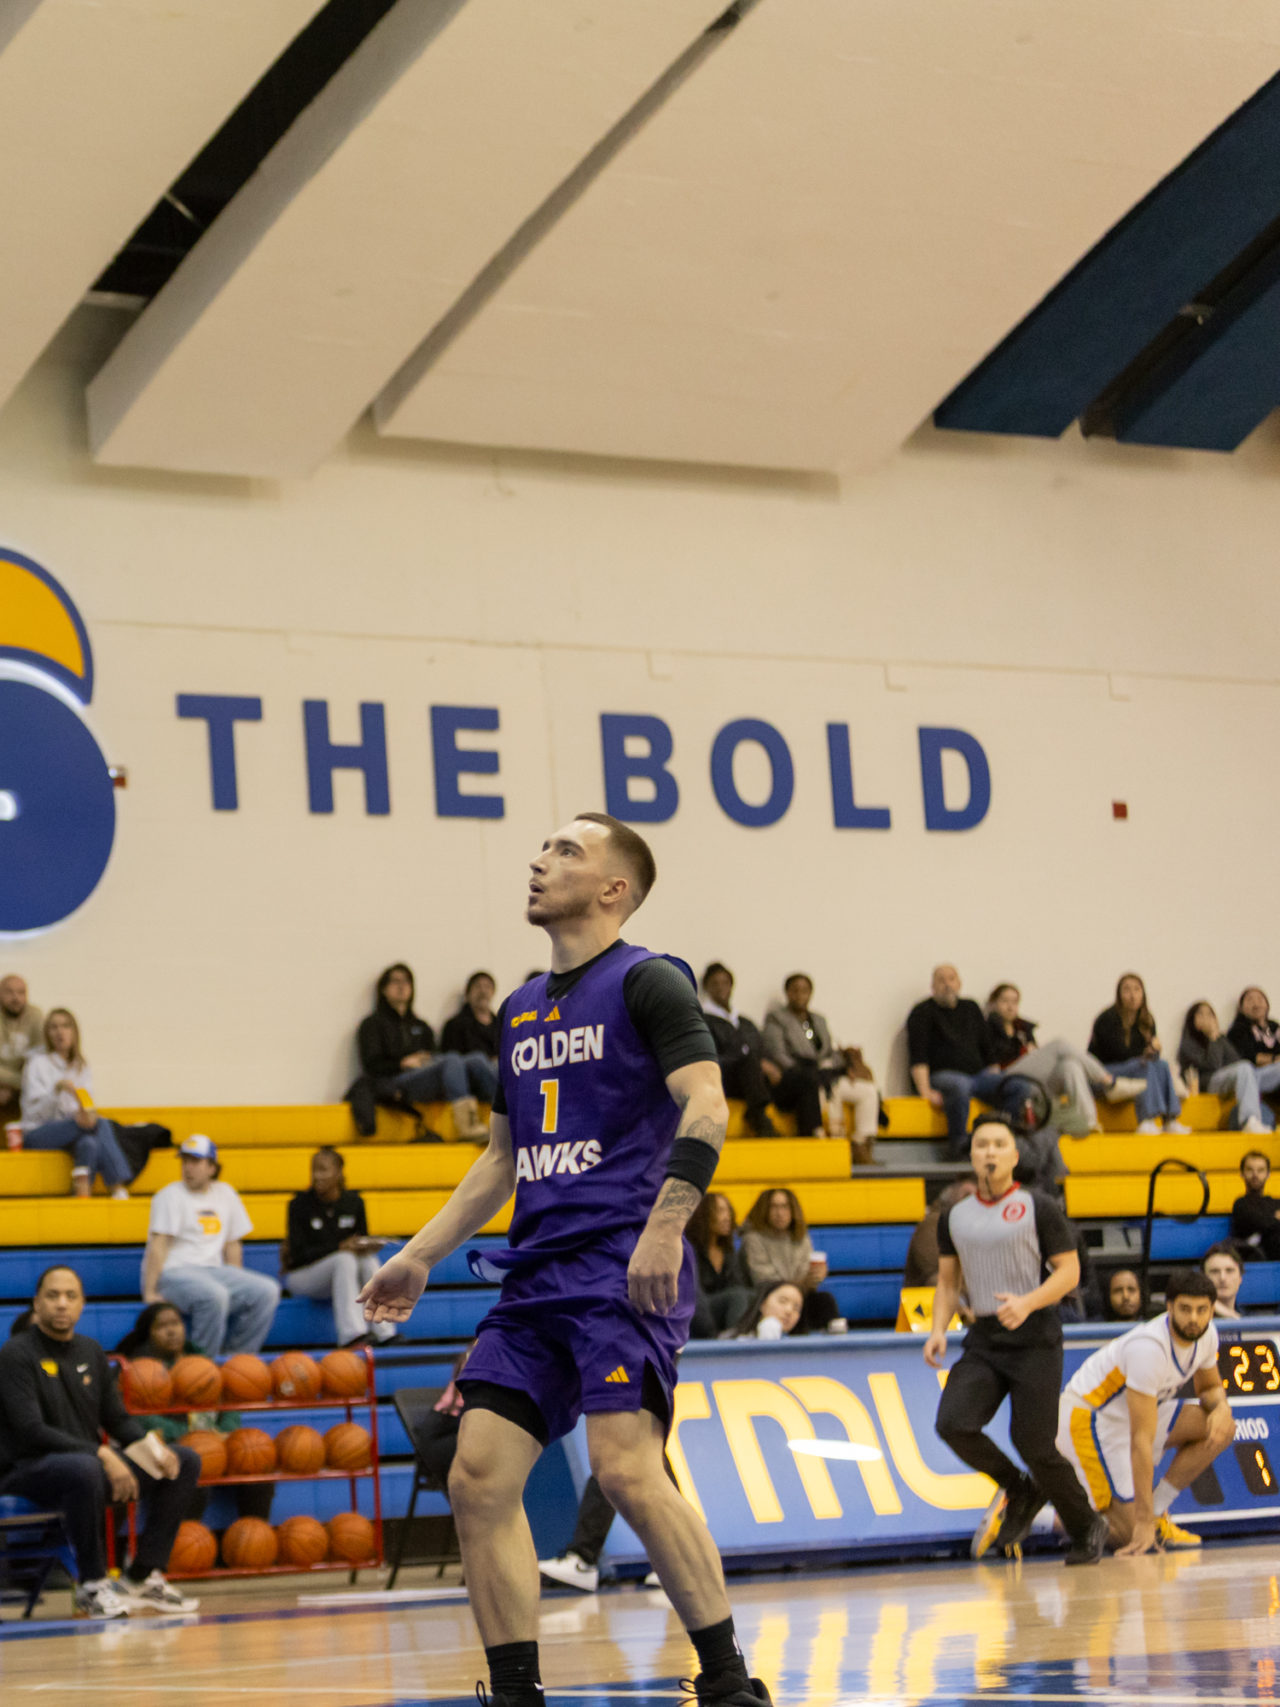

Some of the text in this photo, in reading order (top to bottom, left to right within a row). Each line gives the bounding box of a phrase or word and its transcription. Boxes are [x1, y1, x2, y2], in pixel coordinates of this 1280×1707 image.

[176, 693, 505, 819] THE
[599, 711, 992, 832] BOLD
[540, 1078, 559, 1134] 1
[1255, 1449, 1271, 1488] 1
